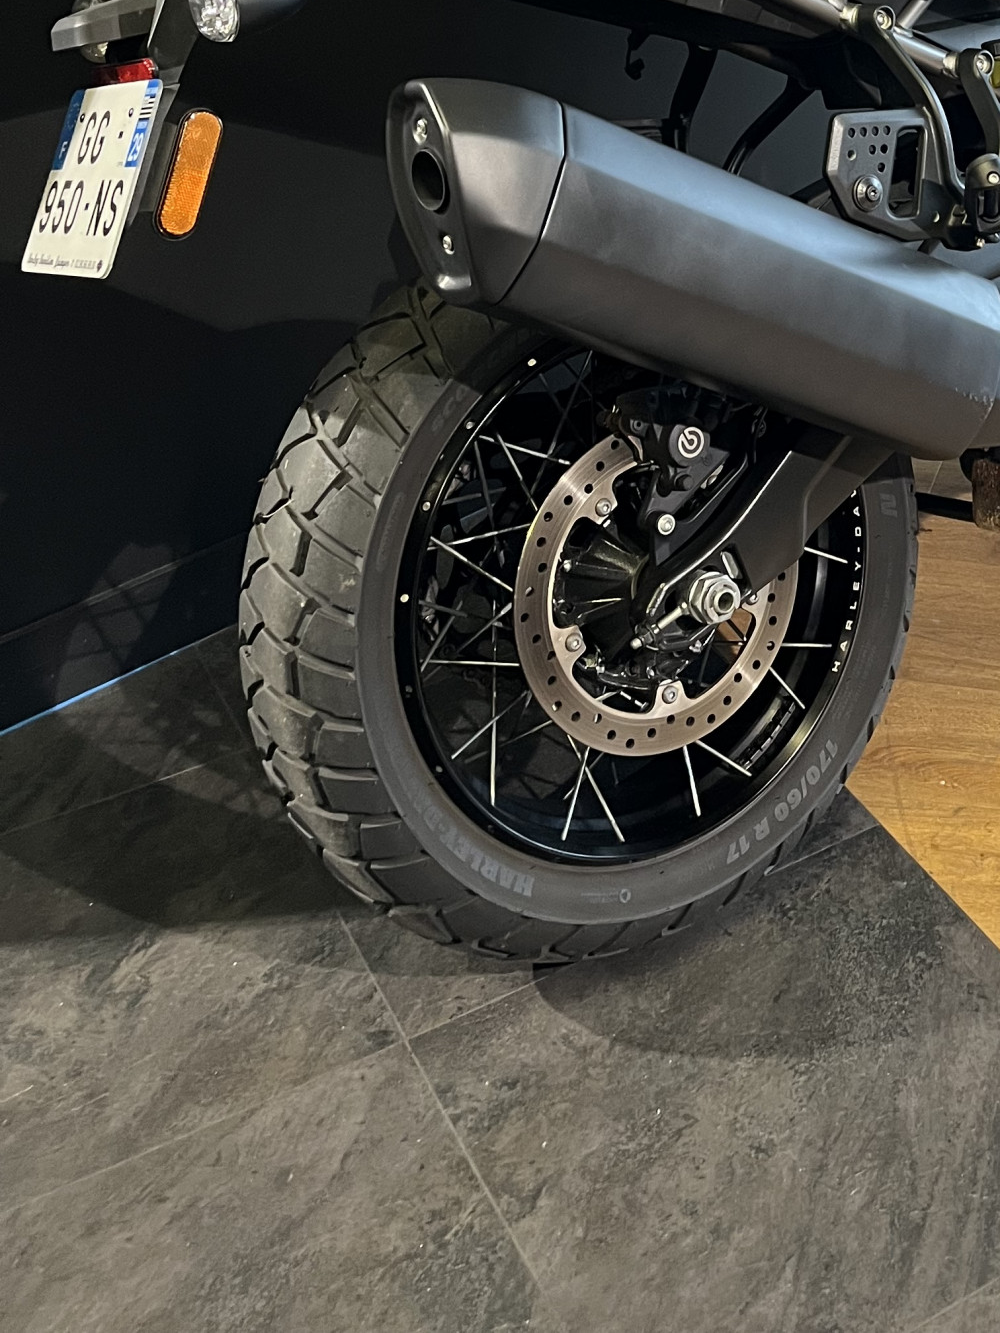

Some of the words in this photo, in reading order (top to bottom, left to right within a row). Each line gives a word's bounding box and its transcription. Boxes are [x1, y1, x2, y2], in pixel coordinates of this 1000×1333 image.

[127, 132, 144, 162] 29
[38, 179, 124, 237] 950-NS
[773, 738, 839, 822] 170/60
[752, 816, 771, 841] R
[726, 834, 751, 865] 17
